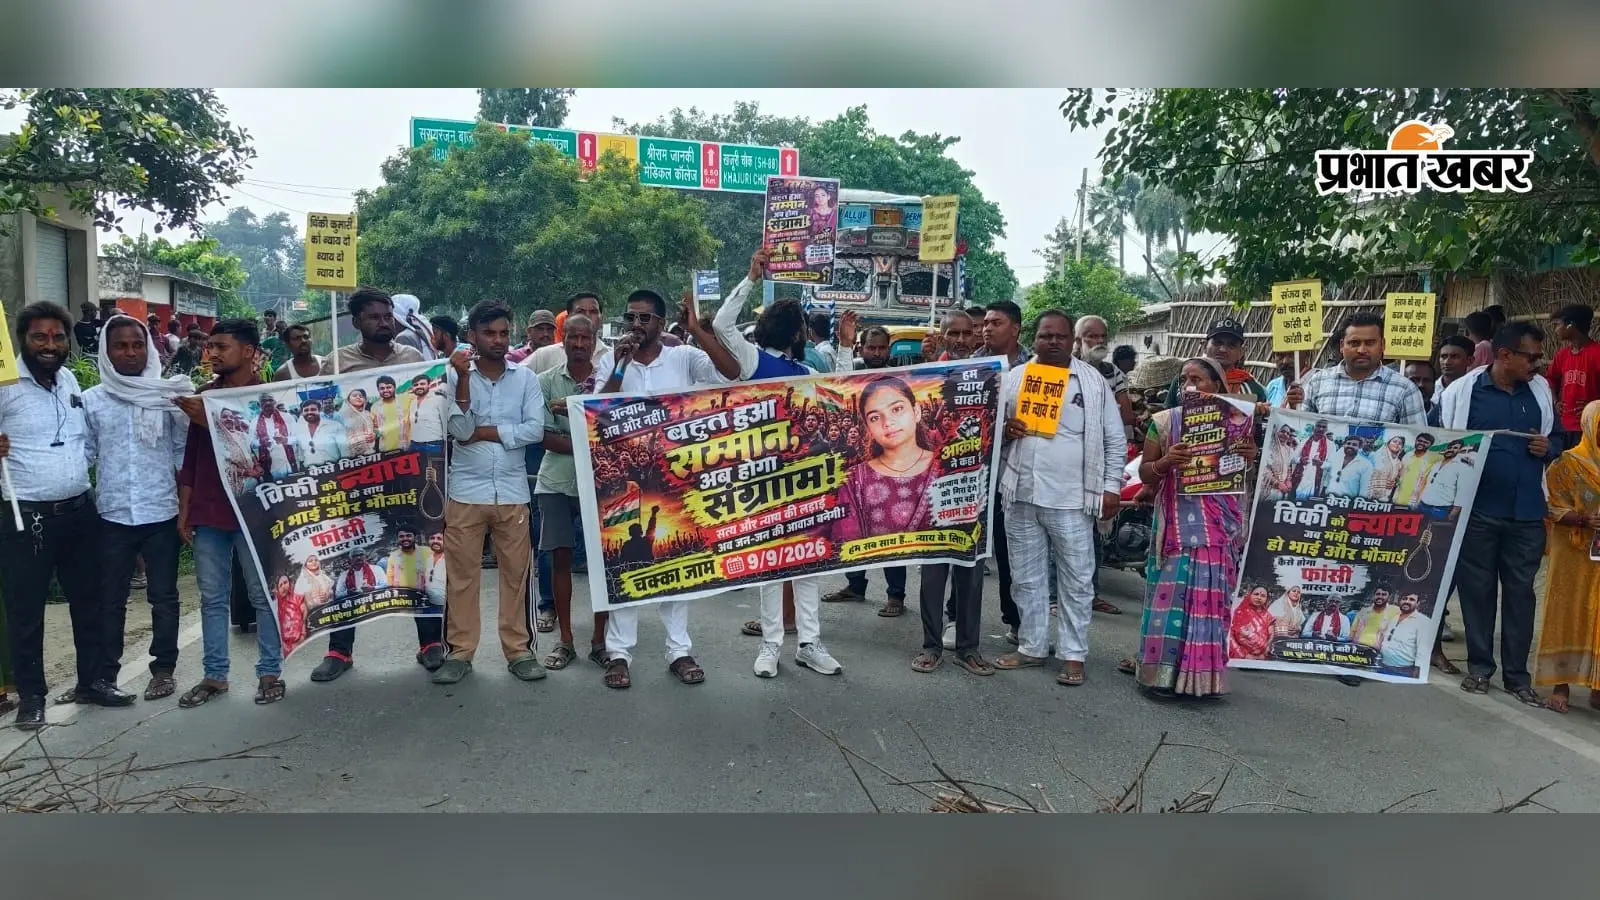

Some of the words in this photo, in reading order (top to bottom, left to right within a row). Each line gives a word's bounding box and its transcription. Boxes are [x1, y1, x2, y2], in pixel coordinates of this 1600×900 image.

[457, 130, 474, 145] बाज
[647, 143, 667, 161] श्रीराम
[669, 146, 694, 164] जानकी
[643, 161, 672, 180] मेडिकल
[674, 164, 697, 182] कॉलेज
[723, 171, 752, 185] KHAJURI
[753, 174, 767, 186] CHO
[330, 217, 352, 233] कुमारी
[311, 232, 321, 245] को
[323, 235, 341, 245] न्याय
[342, 234, 351, 246] दो
[316, 251, 334, 262] न्याय
[336, 250, 345, 262] दो
[316, 268, 334, 278] न्याय
[336, 267, 345, 278] दो
[1276, 303, 1286, 314] को
[1288, 300, 1307, 314] फांसी
[1308, 300, 1317, 312] दो
[1283, 316, 1302, 329] फांसी
[1303, 316, 1311, 328] दो
[1283, 331, 1302, 344] फांसी
[1303, 331, 1312, 343] दो
[962, 369, 978, 381] हम
[957, 381, 984, 392] न्याय
[1043, 380, 1064, 402] कुमारी
[954, 392, 981, 405] चाहते
[1021, 397, 1031, 415] को
[1032, 402, 1049, 419] न्याय
[1050, 401, 1059, 420] दो
[609, 401, 646, 420] अन्याय
[664, 412, 728, 442] बहुत
[733, 399, 777, 431] हुआ
[602, 423, 621, 439] अब
[623, 418, 643, 434] और
[643, 409, 667, 428] नहीं!
[665, 420, 799, 478] सम्मान,
[308, 462, 335, 476] कैसे
[338, 452, 382, 471] मिलेगा
[320, 480, 337, 492] को
[336, 452, 421, 489] न्याय
[950, 457, 957, 468] ने
[959, 456, 975, 466] कहा
[700, 467, 732, 490] अब
[738, 456, 777, 480] होगा
[296, 499, 316, 508] जब
[319, 490, 347, 505] मंत्री
[349, 488, 360, 499] के
[362, 485, 384, 496] साथ
[940, 498, 951, 506] अब
[1326, 494, 1350, 509] कैसे
[1353, 497, 1392, 512] मिलेगा
[270, 520, 285, 540] हो
[287, 505, 322, 527] भाई
[326, 499, 362, 519] और
[366, 488, 418, 509] भौजाई
[716, 526, 737, 541] सत्य
[740, 517, 758, 533] और
[760, 512, 781, 527] न्याय
[784, 504, 797, 519] की
[799, 494, 826, 515] लड़ाई
[937, 507, 961, 520] संग्राम
[284, 530, 300, 546] कैसे
[302, 523, 323, 537] होगा
[309, 516, 366, 548] फांसी
[718, 541, 733, 553] अब
[735, 533, 770, 549] जन-जन
[772, 525, 785, 538] की
[787, 517, 815, 534] आवाज
[817, 507, 845, 525] बनेगी!
[1330, 515, 1346, 527] को
[1347, 513, 1424, 537] न्याय
[318, 541, 350, 556] मास्टर
[353, 534, 375, 547] को?
[848, 543, 861, 555] हम
[863, 541, 878, 551] सब
[880, 538, 897, 547] साथ
[915, 534, 935, 542] न्याय
[937, 532, 946, 542] के
[949, 532, 966, 545] लिए!
[1304, 530, 1322, 539] जब
[1324, 529, 1350, 543] मंत्री
[1350, 534, 1362, 545] के
[1364, 537, 1382, 547] साथ
[748, 540, 826, 570] 9/9/2026
[1266, 536, 1285, 552] हो
[1288, 539, 1322, 557] भाई
[1324, 542, 1359, 561] और
[1361, 546, 1409, 567] भौजाई
[1278, 557, 1297, 567] कैसे
[1297, 557, 1316, 567] होगा
[633, 570, 681, 593] चक्का
[682, 558, 715, 581] जाम
[1301, 564, 1354, 584] फांसी
[375, 590, 392, 600] जारी
[1301, 583, 1332, 592] मास्टर
[1335, 584, 1357, 594] को?
